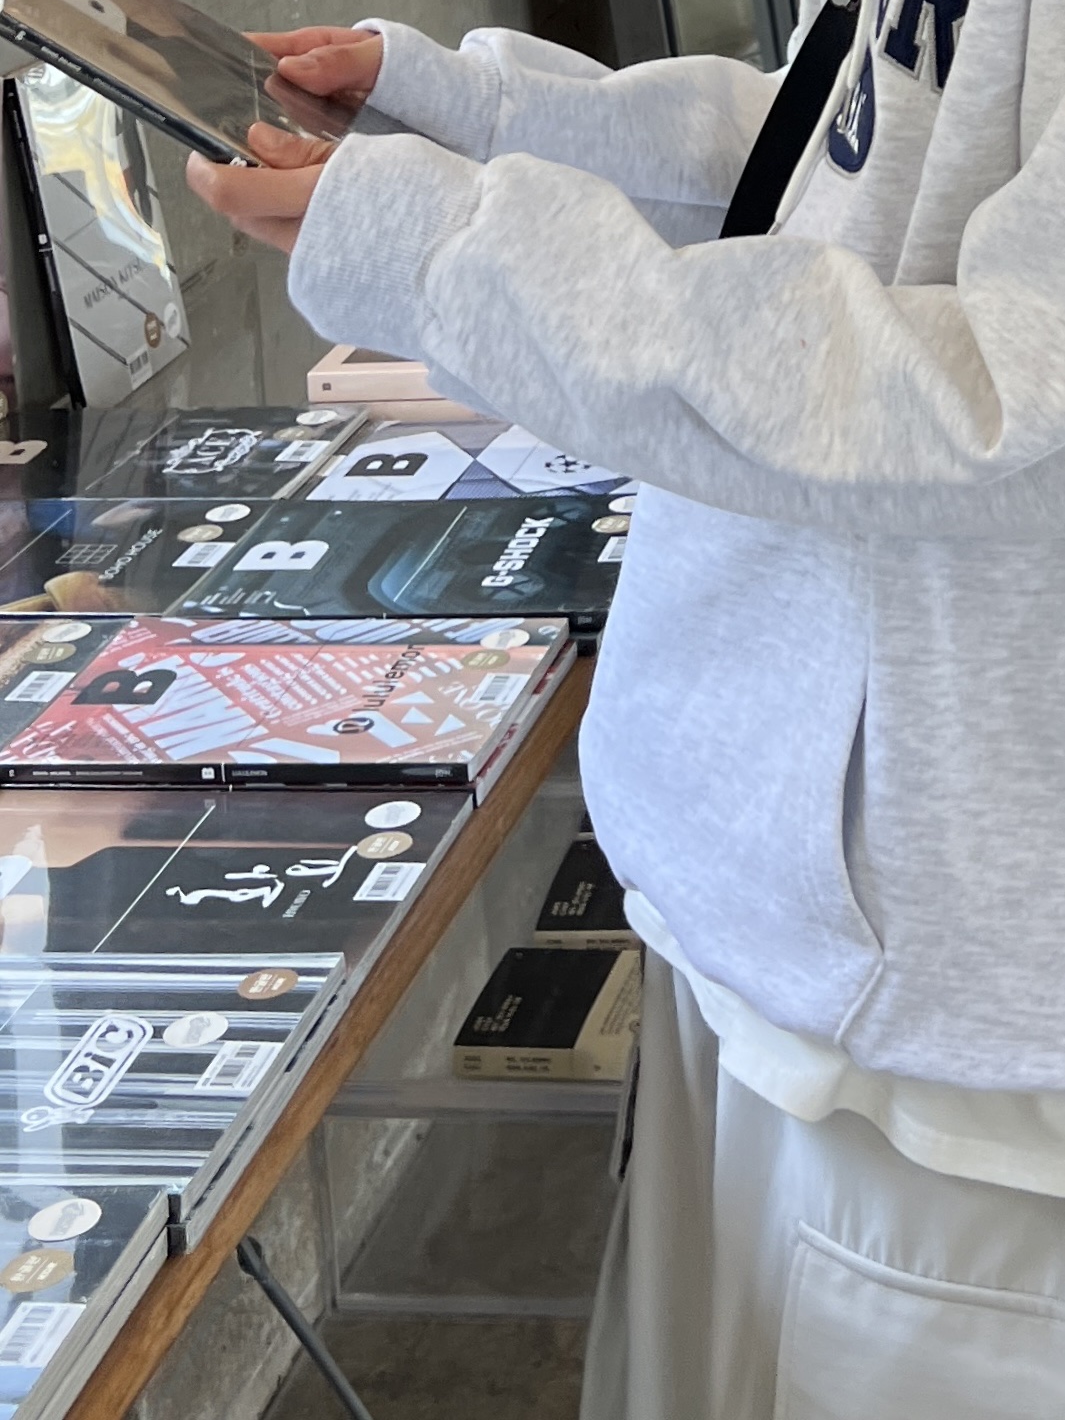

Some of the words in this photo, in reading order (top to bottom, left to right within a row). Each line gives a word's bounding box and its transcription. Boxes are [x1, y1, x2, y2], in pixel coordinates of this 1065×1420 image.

[344, 452, 429, 477] B
[233, 539, 330, 571] B
[481, 516, 555, 588] G-SHOCK
[71, 668, 178, 705] B
